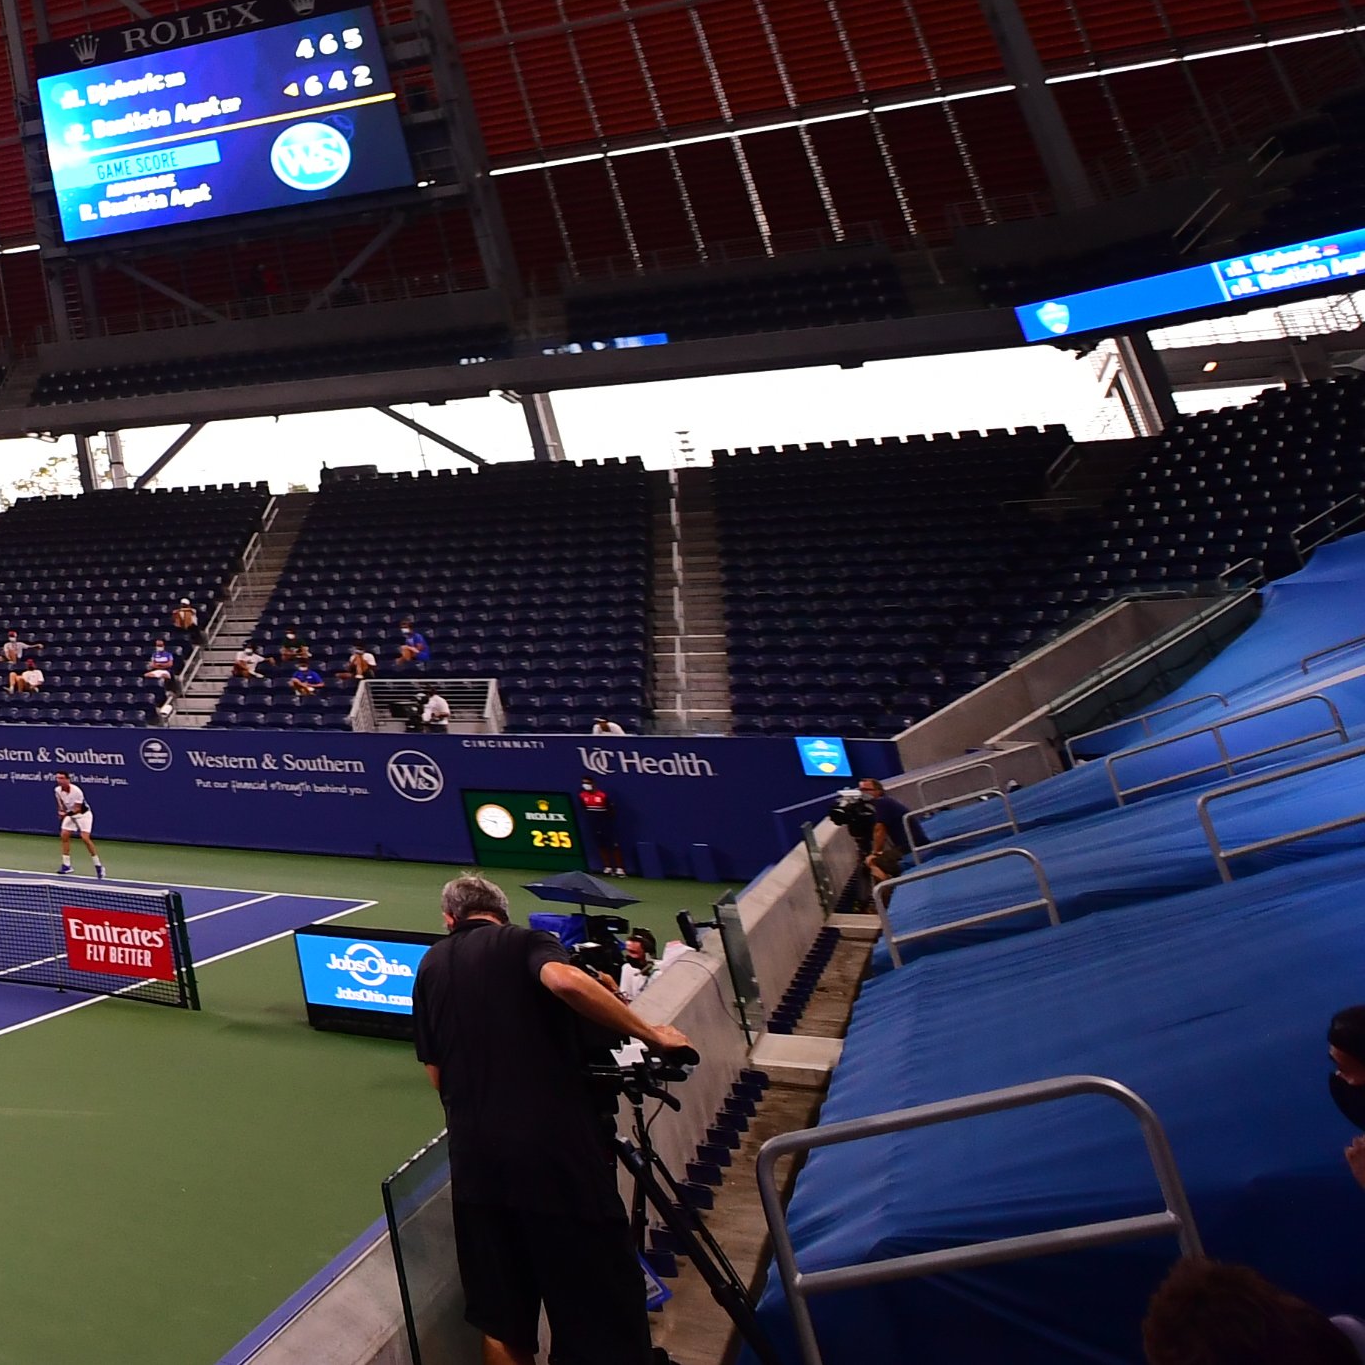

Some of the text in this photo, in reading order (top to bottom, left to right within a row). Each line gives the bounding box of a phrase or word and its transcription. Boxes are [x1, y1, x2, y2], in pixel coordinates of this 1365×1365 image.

[123, 0, 264, 53] ROLEX
[295, 27, 364, 59] 4 6 5
[87, 73, 165, 106] Djokovic
[304, 65, 373, 97] 6 4 2
[92, 107, 171, 139] Bautista
[97, 151, 178, 180] GAME SCORE
[98, 192, 168, 220] Bautista
[36, 747, 52, 763] &
[54, 747, 126, 766] Southern
[462, 739, 546, 749] CINCINNATI
[187, 750, 258, 770] Western
[261, 751, 279, 771] &
[283, 752, 365, 774] Southern
[617, 749, 715, 777] Health
[10, 771, 42, 783] financial
[80, 773, 110, 784] behind
[195, 778, 212, 788] Put
[231, 779, 268, 793] financial
[270, 780, 312, 797] strength
[313, 783, 348, 794] behind
[389, 763, 439, 792] W&S
[525, 811, 567, 822] ROLEX
[531, 829, 572, 849] 2:35
[68, 917, 164, 948] Emirates
[86, 943, 152, 968] FLY BETTER
[326, 953, 413, 977] JobsOhio
[335, 986, 413, 1007] JobsOhio.com
